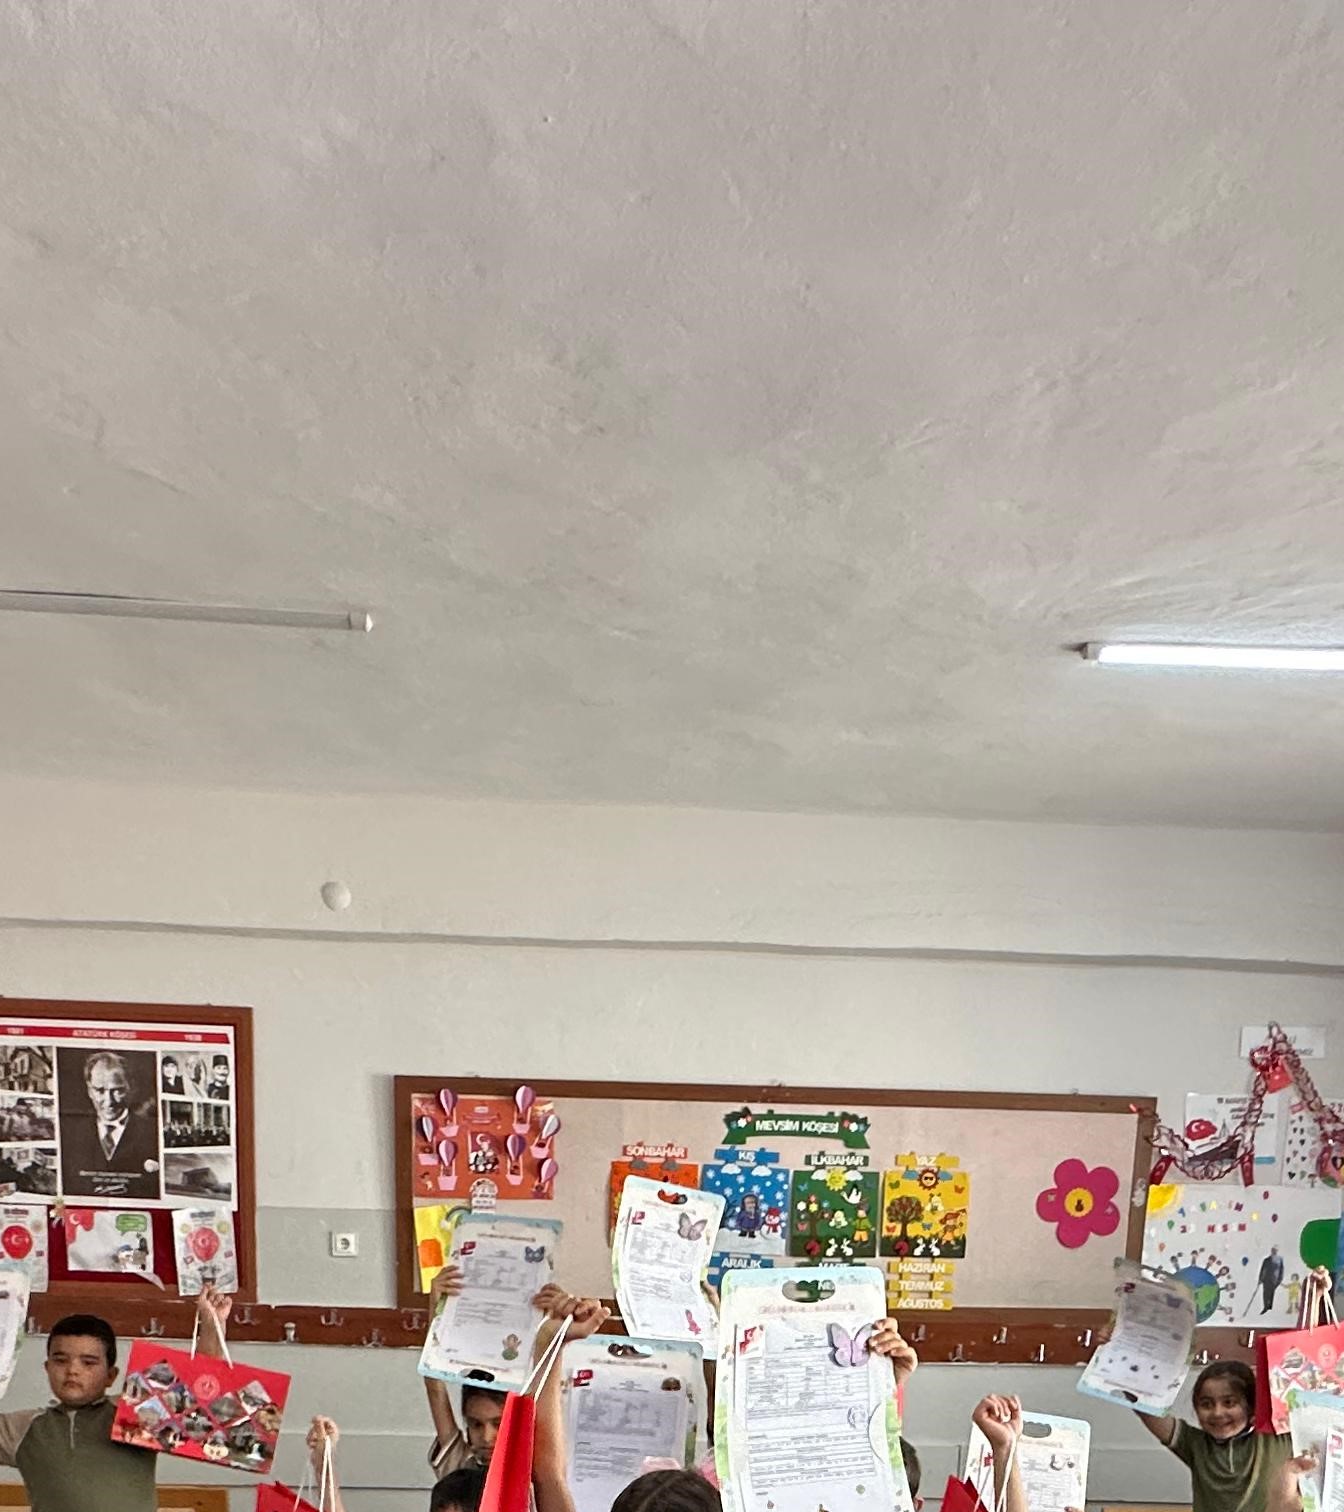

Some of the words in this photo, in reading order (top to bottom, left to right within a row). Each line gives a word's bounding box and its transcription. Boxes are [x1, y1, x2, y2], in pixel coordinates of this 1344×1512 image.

[756, 1120, 799, 1132] MEVSİM
[801, 1119, 840, 1135] KÖŞESİ
[625, 1144, 686, 1159] SONBAHAR
[738, 1150, 756, 1163] KIŞ
[915, 1155, 936, 1167] YAZ
[721, 1258, 762, 1269] ARALIK
[898, 1280, 944, 1291] TEMMUZ
